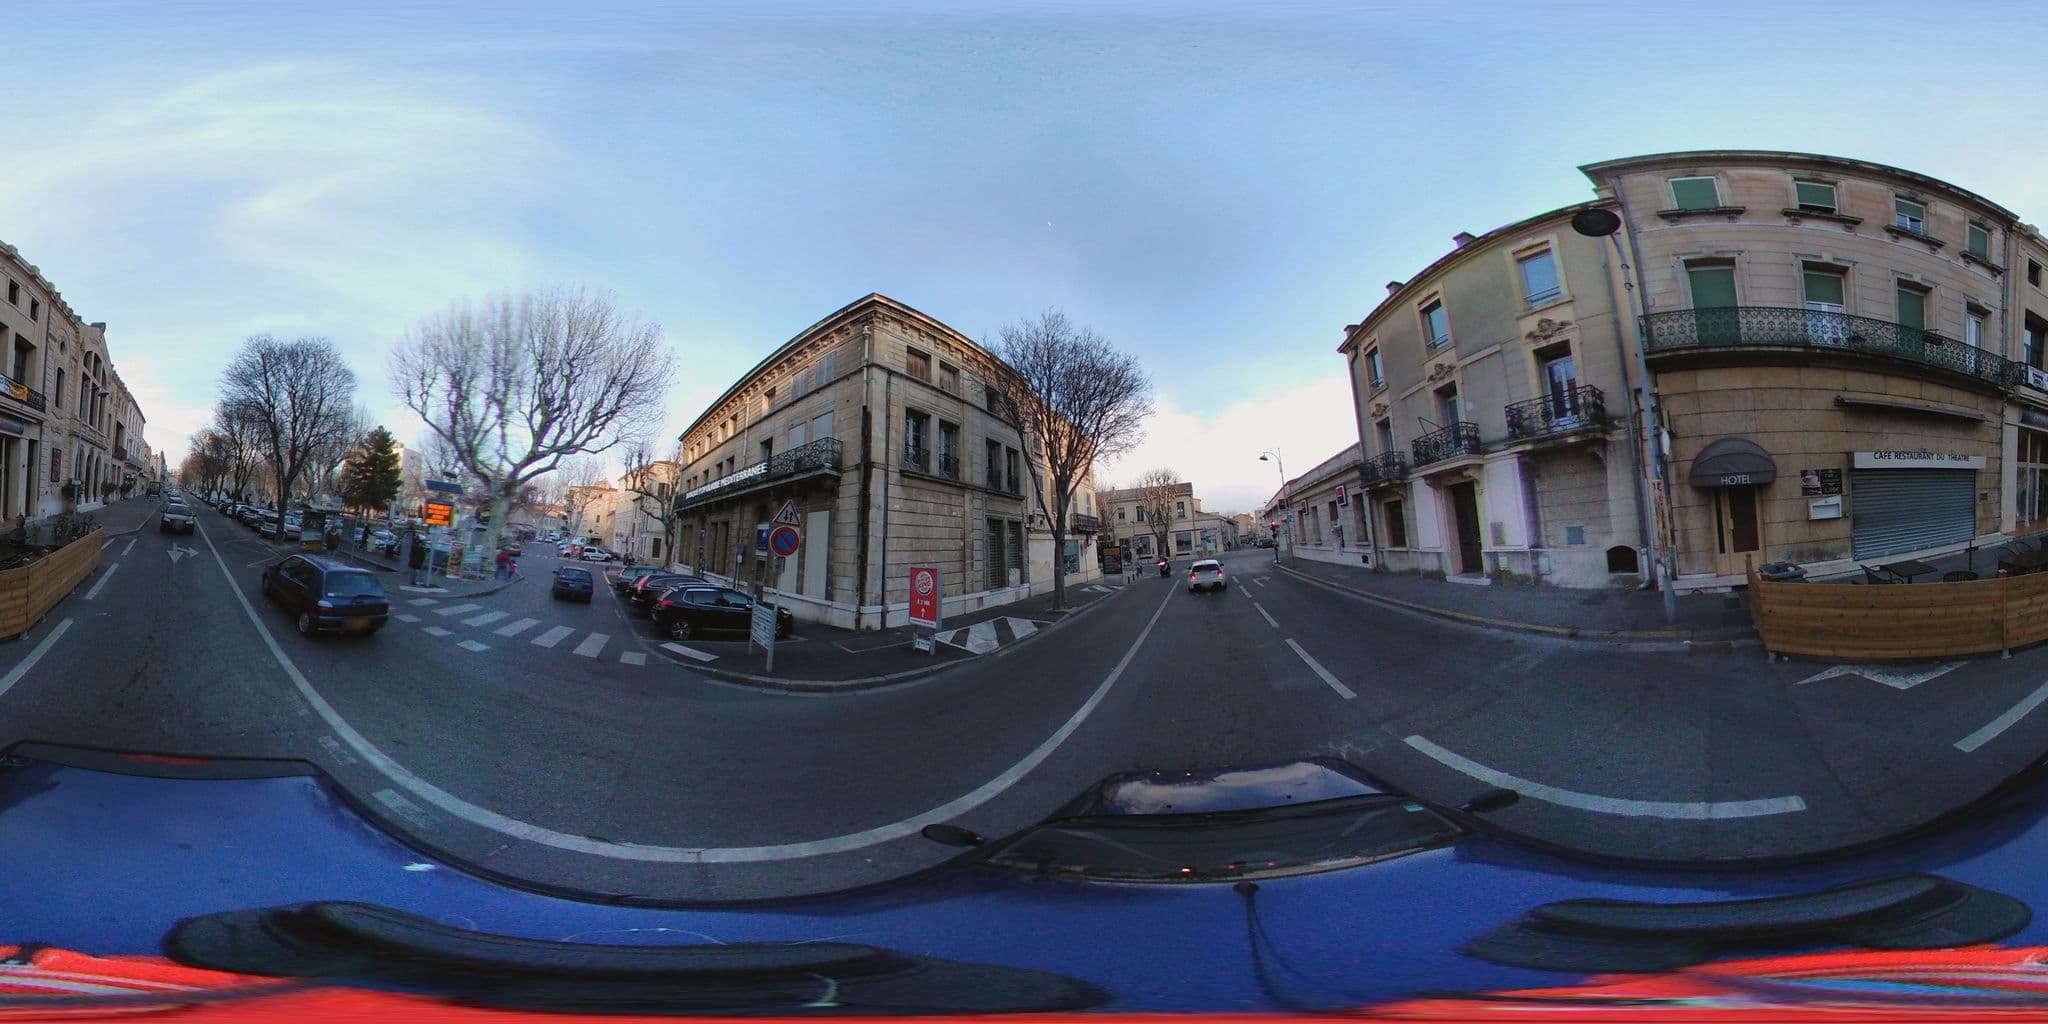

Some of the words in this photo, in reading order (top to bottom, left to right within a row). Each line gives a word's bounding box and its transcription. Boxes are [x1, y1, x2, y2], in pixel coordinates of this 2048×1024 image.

[1894, 452, 1934, 460] RESTAURANT
[1936, 453, 1945, 461] DU
[1720, 474, 1752, 486] HOTEL
